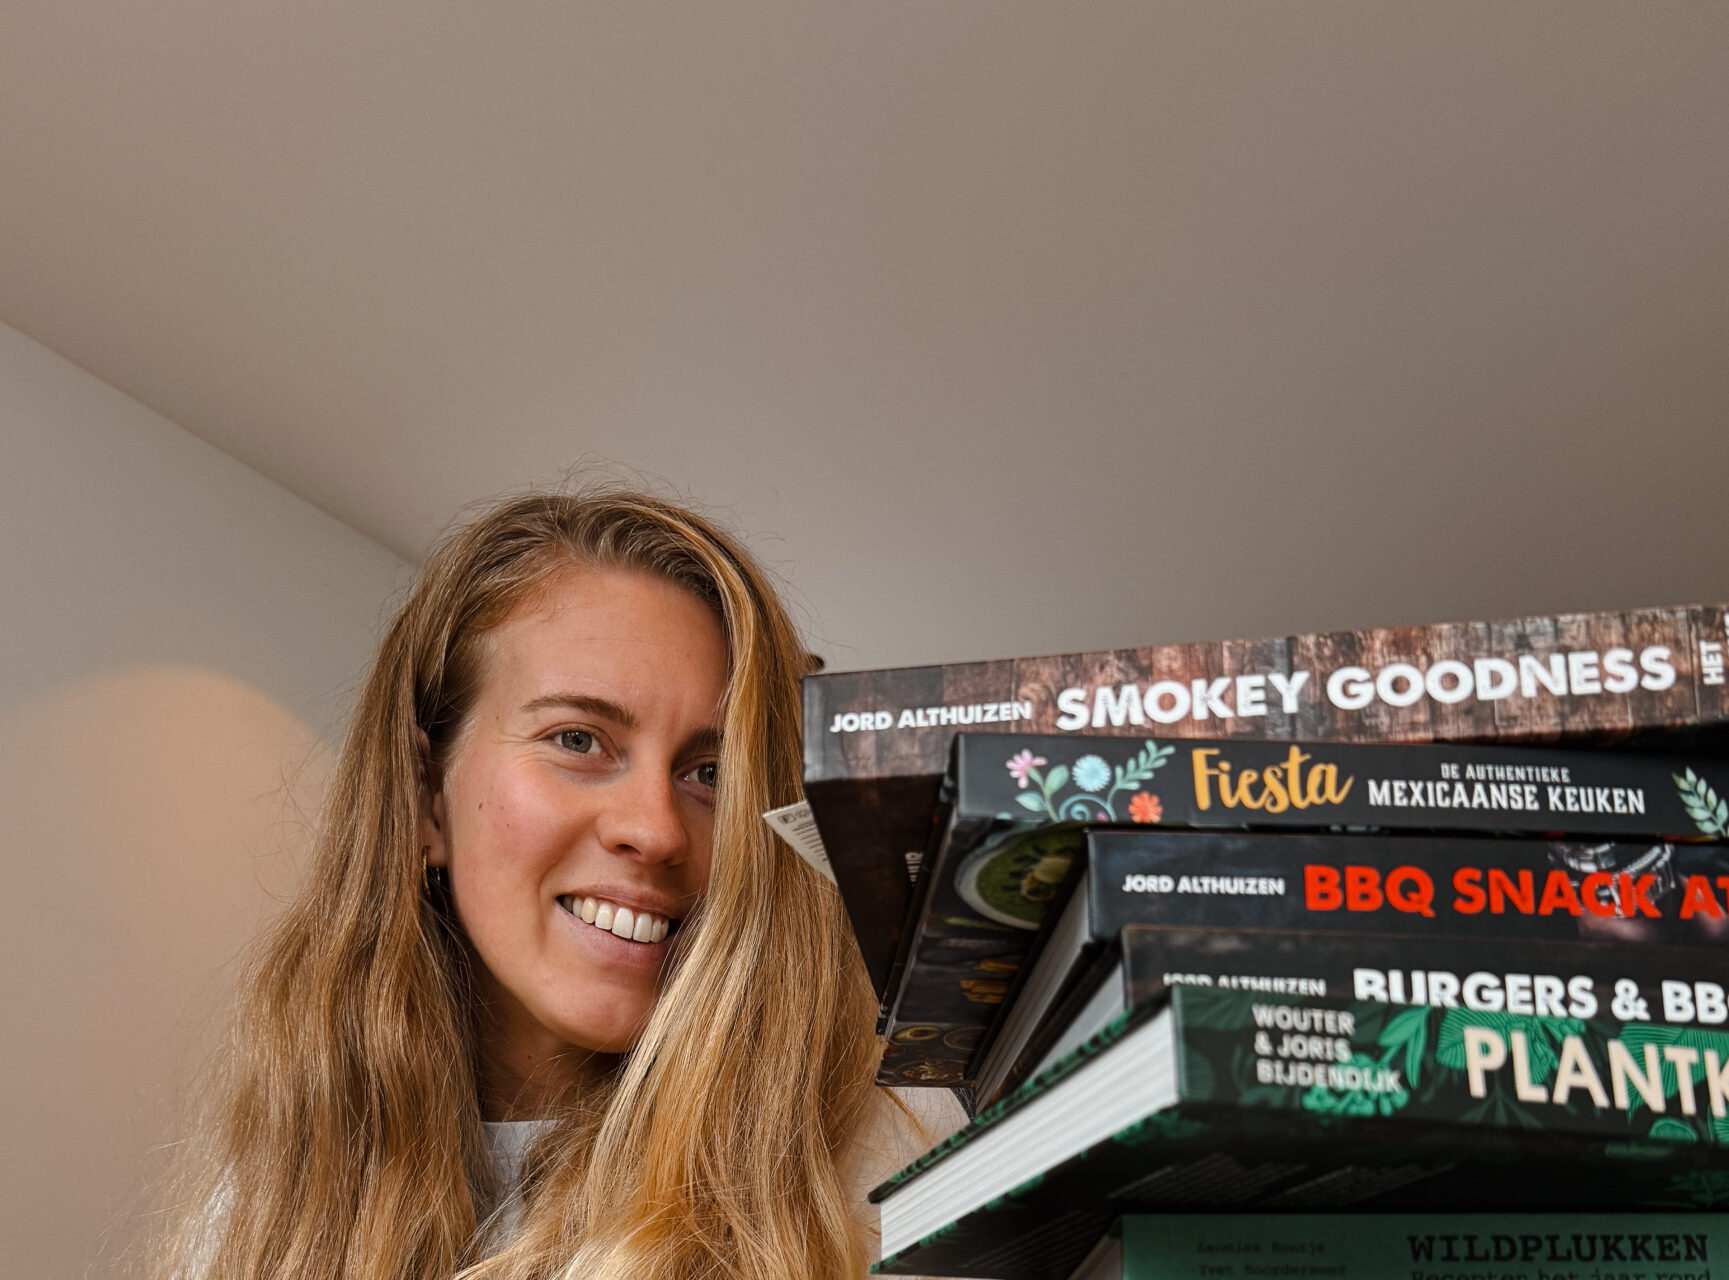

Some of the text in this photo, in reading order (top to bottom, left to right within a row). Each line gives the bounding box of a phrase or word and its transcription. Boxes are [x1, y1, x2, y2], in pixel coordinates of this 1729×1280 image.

[1699, 640, 1725, 686] HET
[1056, 645, 1676, 731] SMOKEY GOODNESS
[830, 701, 1031, 733] JORD ALTHUIZEN
[1192, 745, 1354, 813] Fiesta
[1441, 762, 1571, 783] DE AUTHENTIEKE
[1368, 779, 1646, 815] MEXICAANSE KEUKEN
[1122, 874, 1285, 896] JORD ALTHUIZEN
[1304, 865, 1436, 917] BBQ
[1452, 867, 1662, 918] SNACK
[1354, 968, 1729, 1024] BURGERS & BB
[1252, 1003, 1355, 1035] WOUTER
[1254, 1032, 1352, 1063] & JORIS
[1257, 1059, 1401, 1094] BIJDENDIJK
[1407, 1234, 1708, 1263] WILDPLUKKEN
